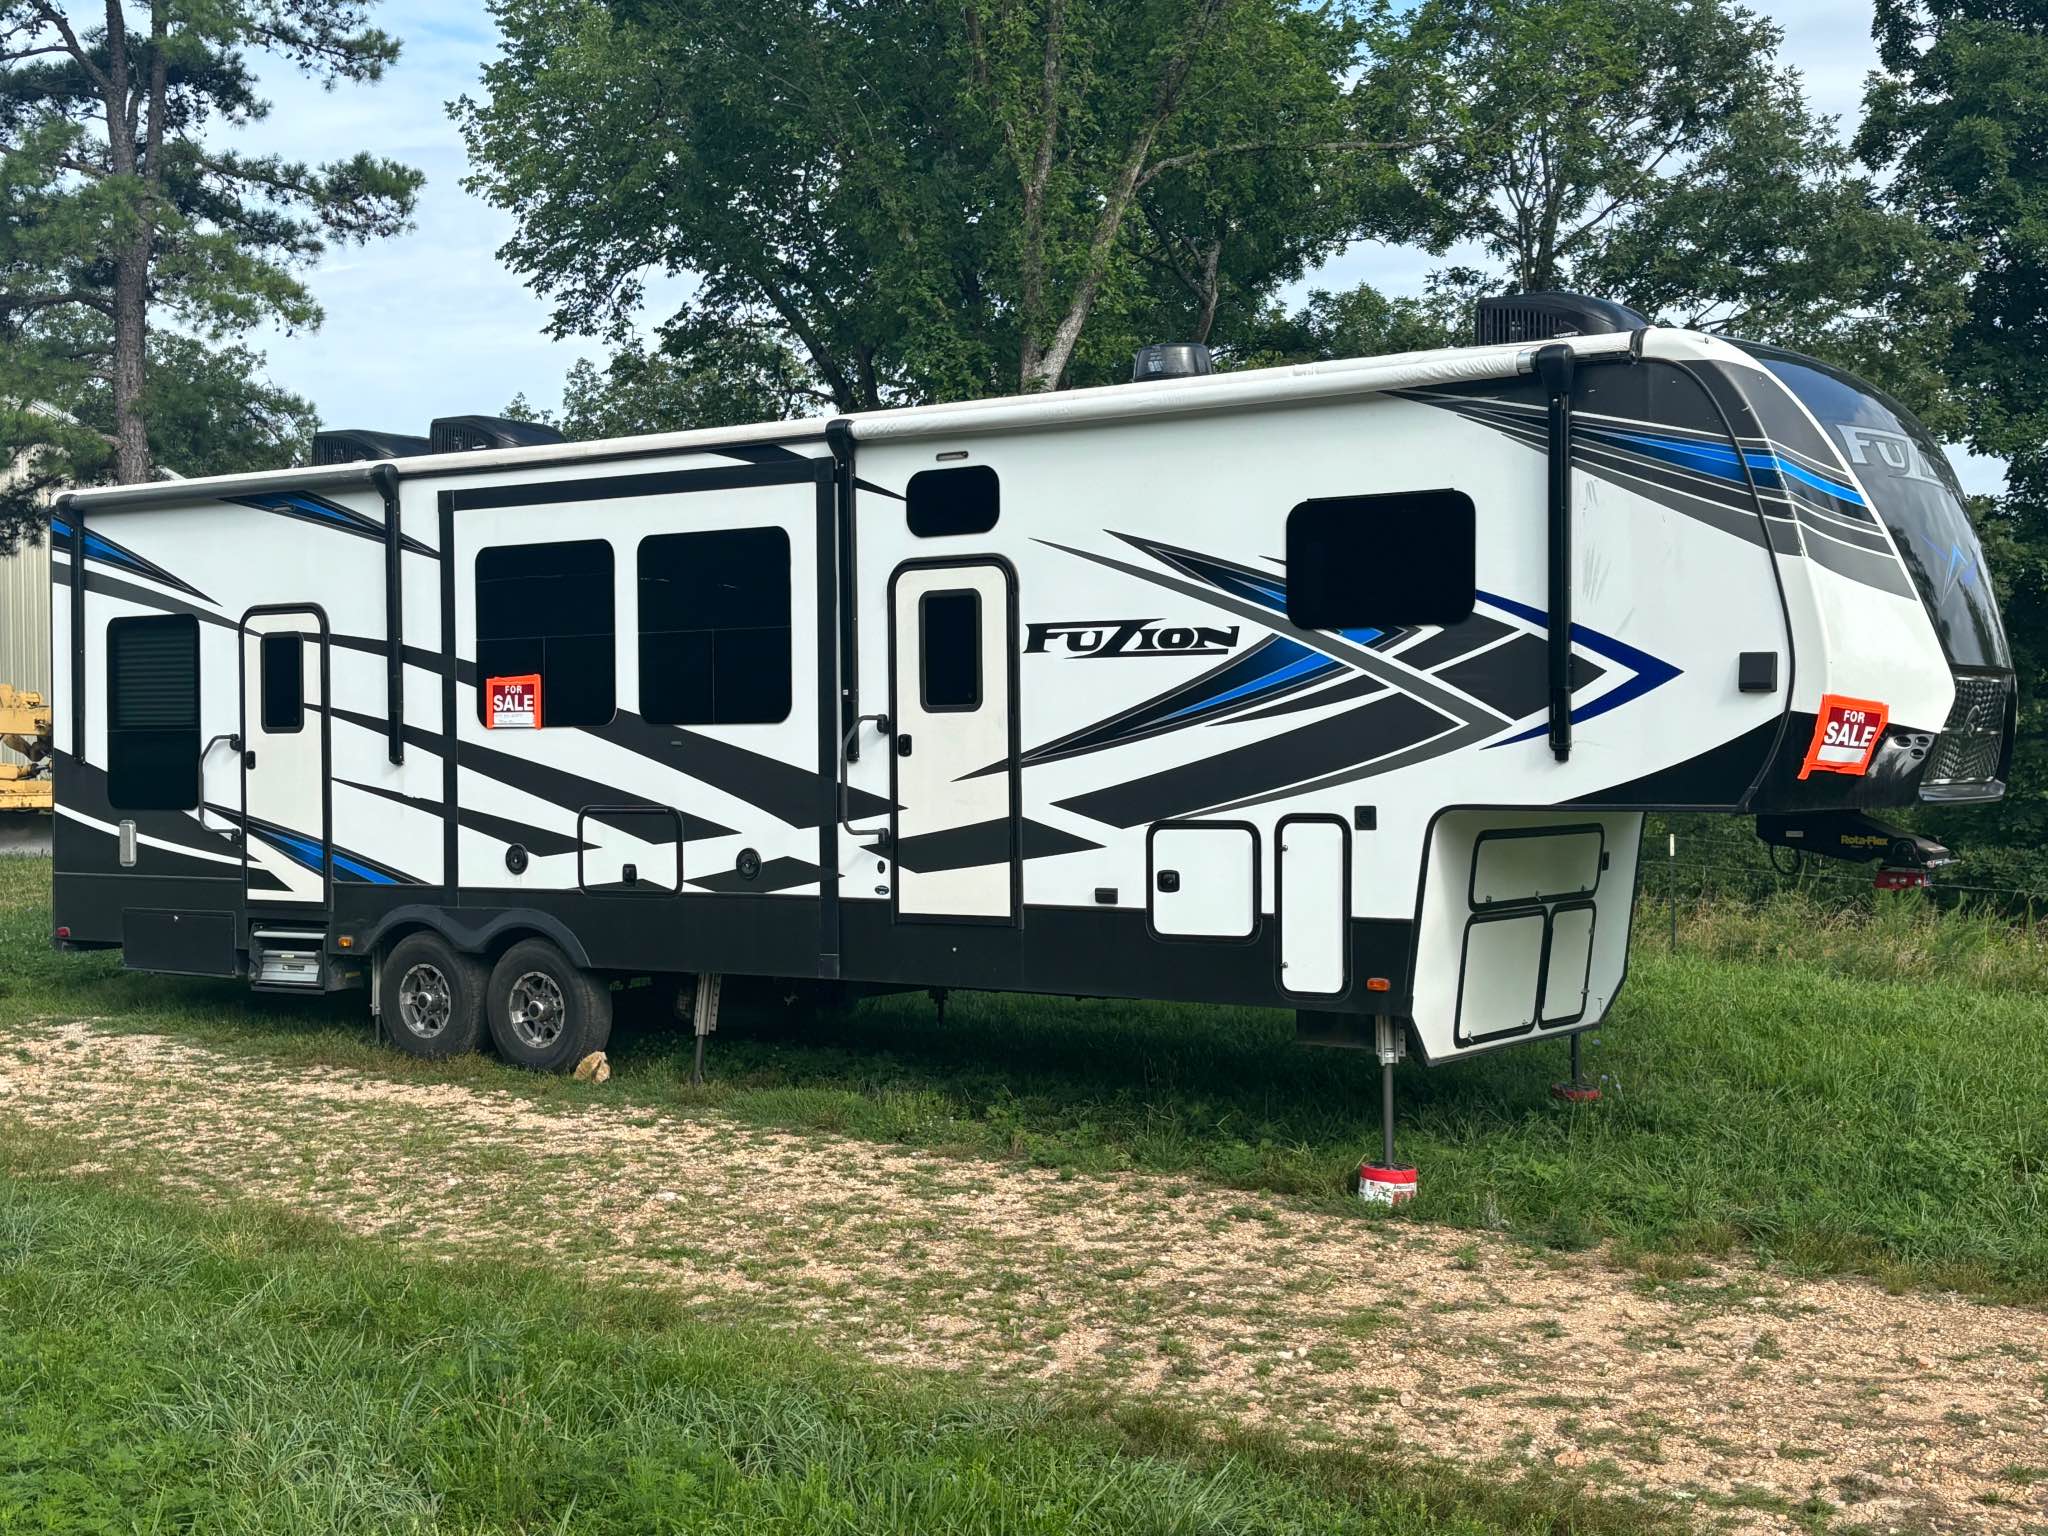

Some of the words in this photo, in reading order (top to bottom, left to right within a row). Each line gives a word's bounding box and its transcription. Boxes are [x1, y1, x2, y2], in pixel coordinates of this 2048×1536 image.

[504, 685, 523, 694] FOR
[493, 694, 534, 712] SALE
[1843, 709, 1866, 724] FOR
[1823, 721, 1877, 747] SALE
